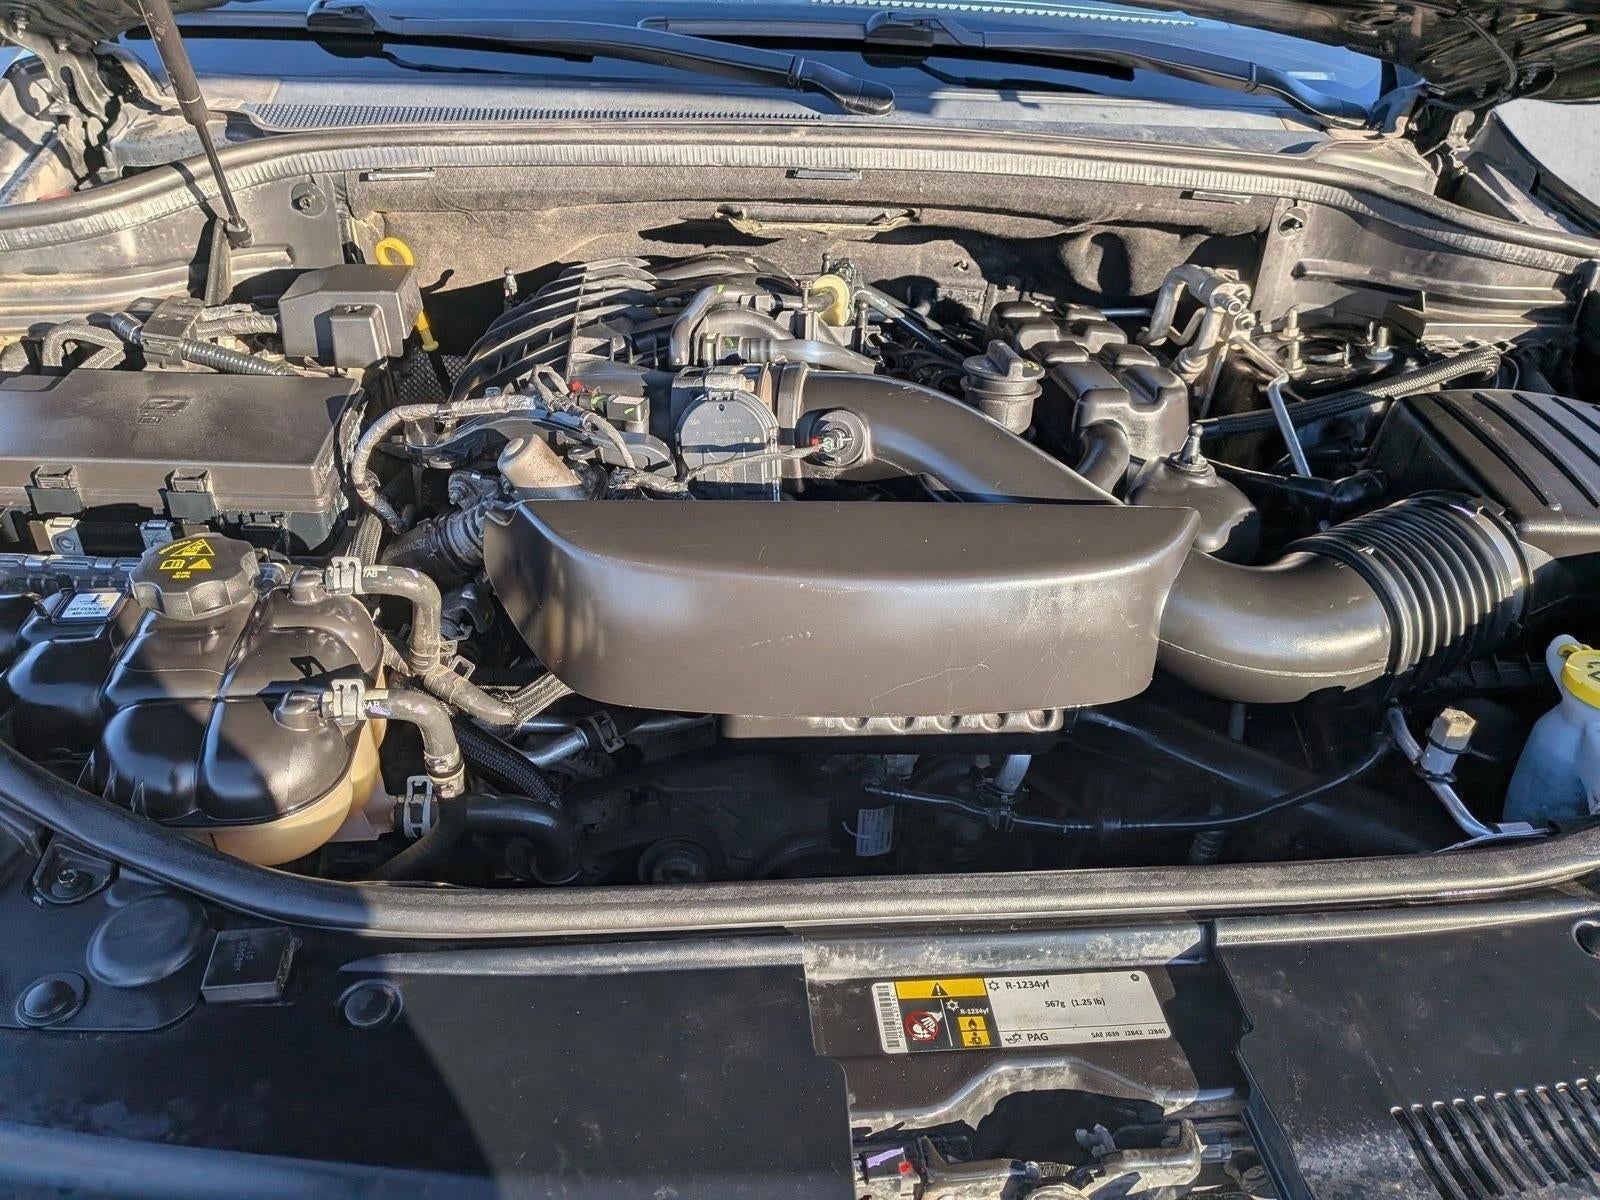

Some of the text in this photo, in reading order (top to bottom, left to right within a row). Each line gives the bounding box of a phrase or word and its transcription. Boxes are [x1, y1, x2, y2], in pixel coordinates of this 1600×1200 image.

[1005, 979, 1050, 990] R-1234yf
[1044, 999, 1066, 1008] 567g
[1071, 997, 1106, 1008] (1.25 lb)
[960, 1007, 989, 1016] R-1234yf
[1026, 1033, 1049, 1042] PAG
